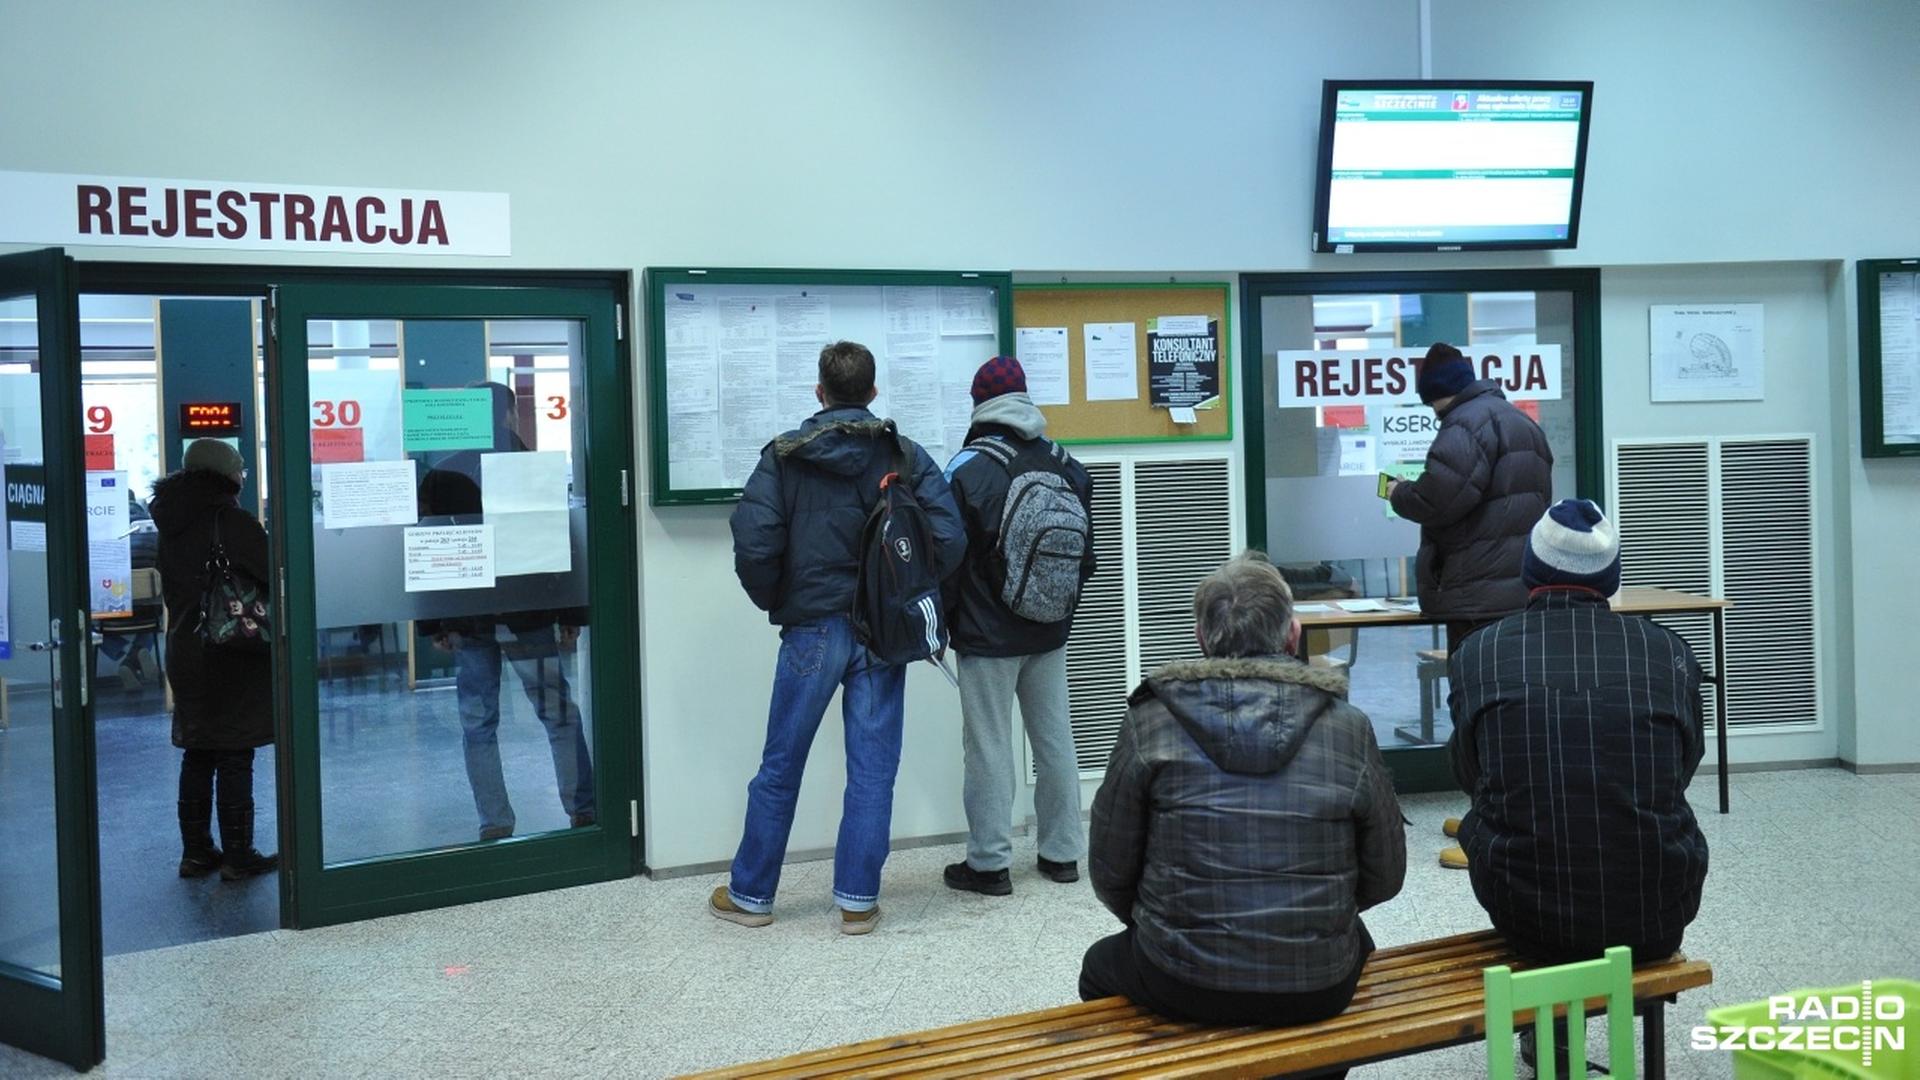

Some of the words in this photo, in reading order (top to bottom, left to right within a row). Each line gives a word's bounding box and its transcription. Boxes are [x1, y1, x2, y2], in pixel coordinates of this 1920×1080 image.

[77, 184, 449, 245] REJESTRACJA
[1152, 350, 1217, 363] TELEFONICZNY
[1153, 338, 1215, 352] KONSULTANT
[1295, 354, 1547, 397] REJESTCJA
[87, 406, 113, 433] 9
[313, 400, 361, 427] 30
